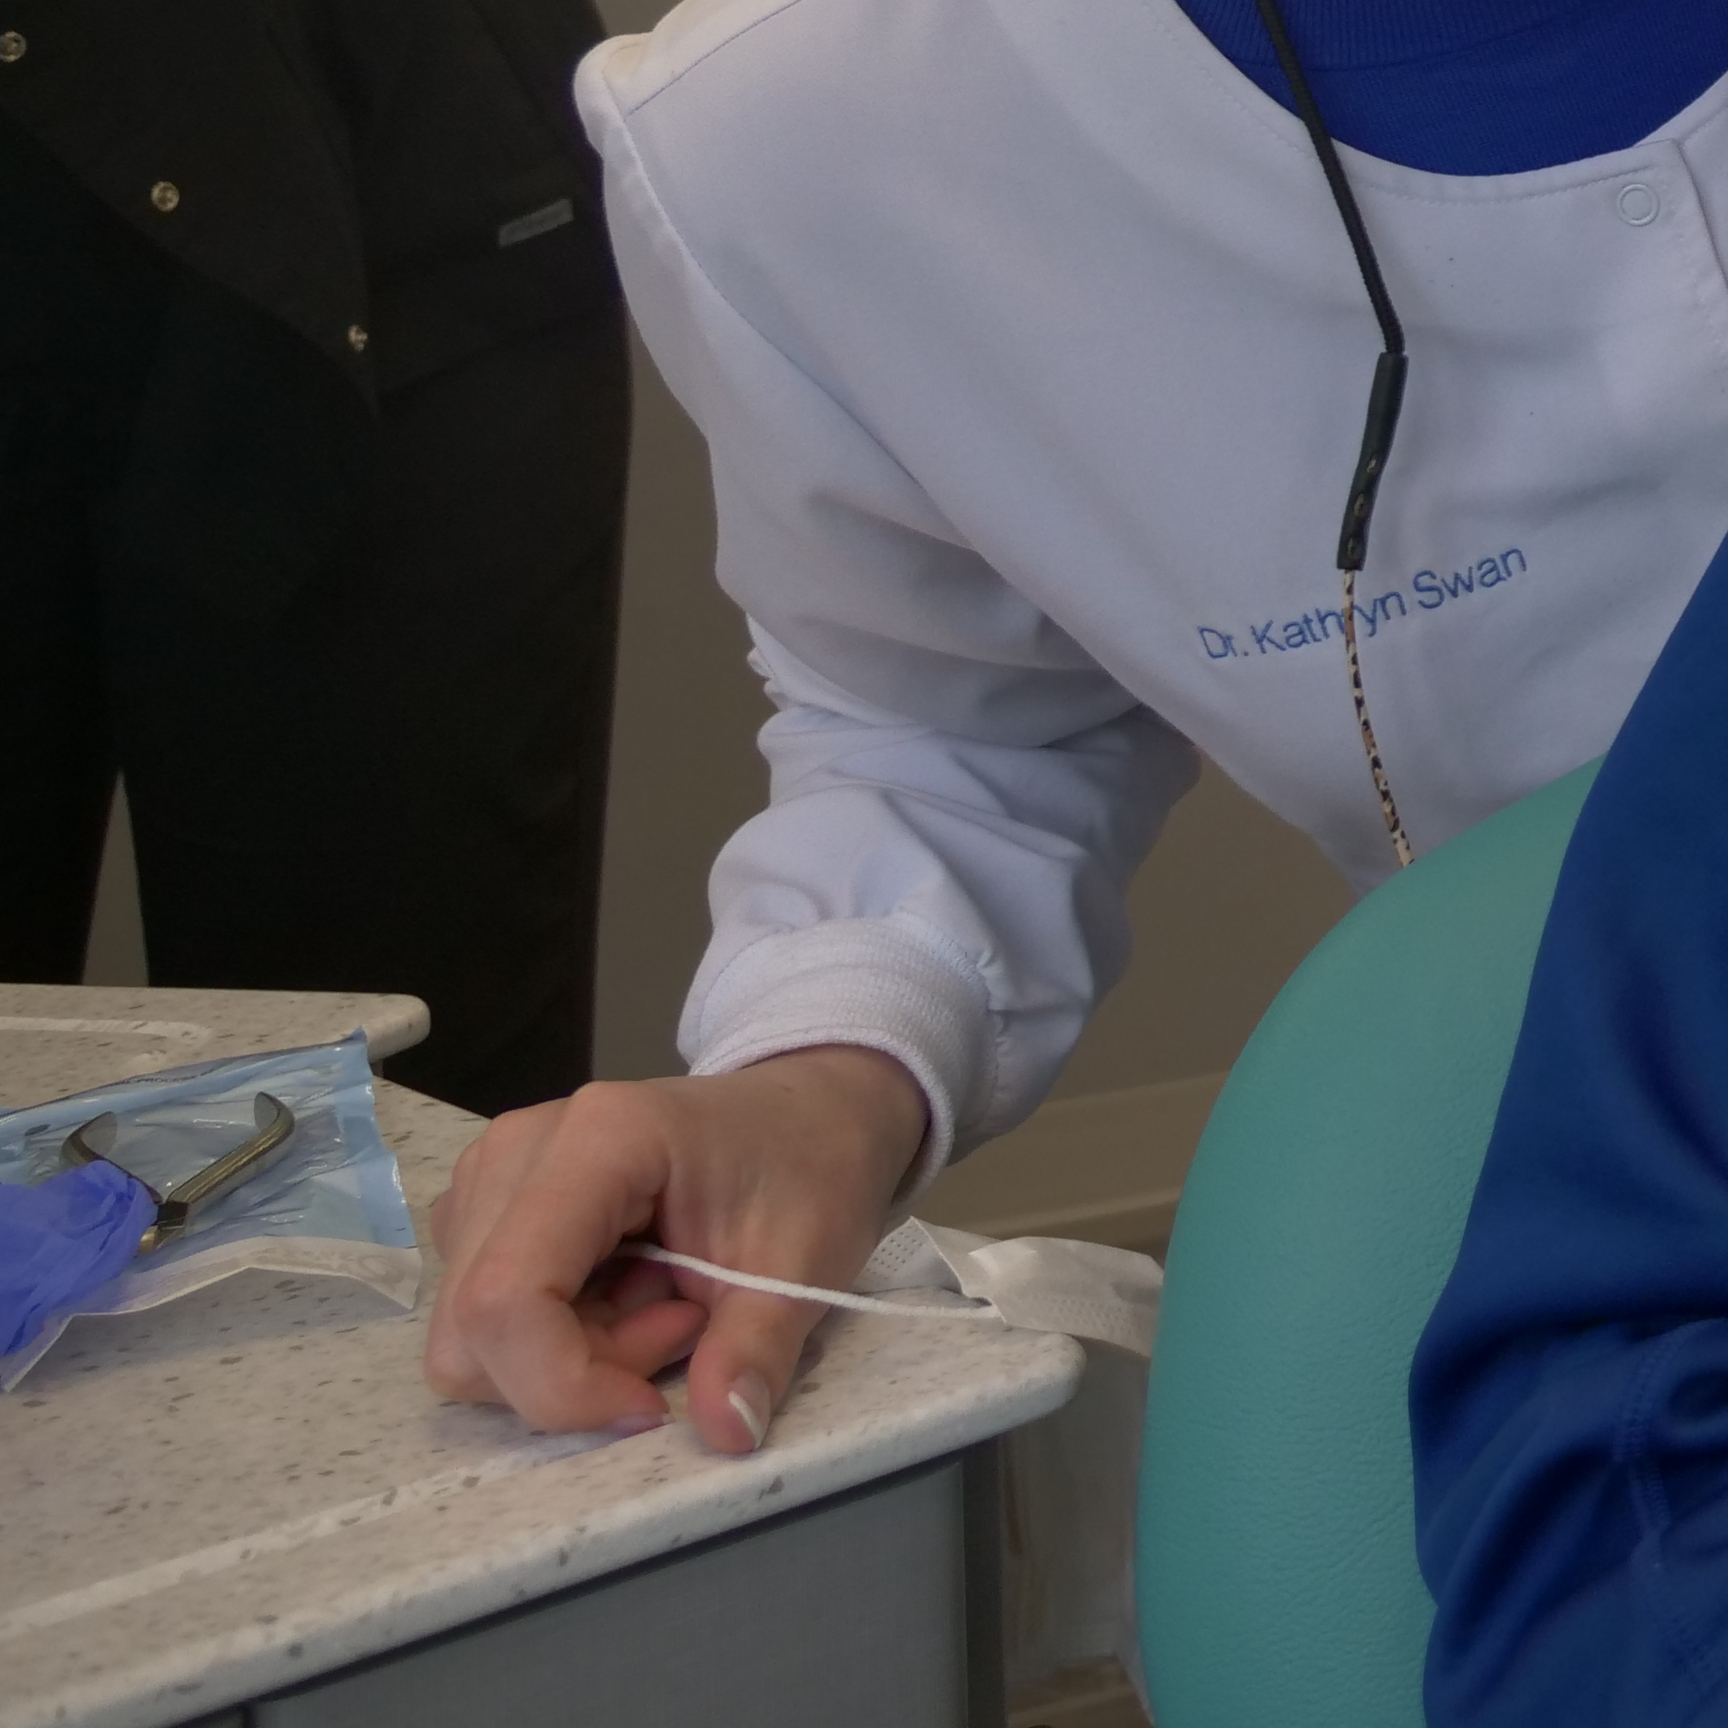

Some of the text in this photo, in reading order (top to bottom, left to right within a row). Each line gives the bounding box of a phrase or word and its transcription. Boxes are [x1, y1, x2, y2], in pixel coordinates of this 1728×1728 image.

[1198, 547, 1528, 659] Dr. Kathyn Swan
